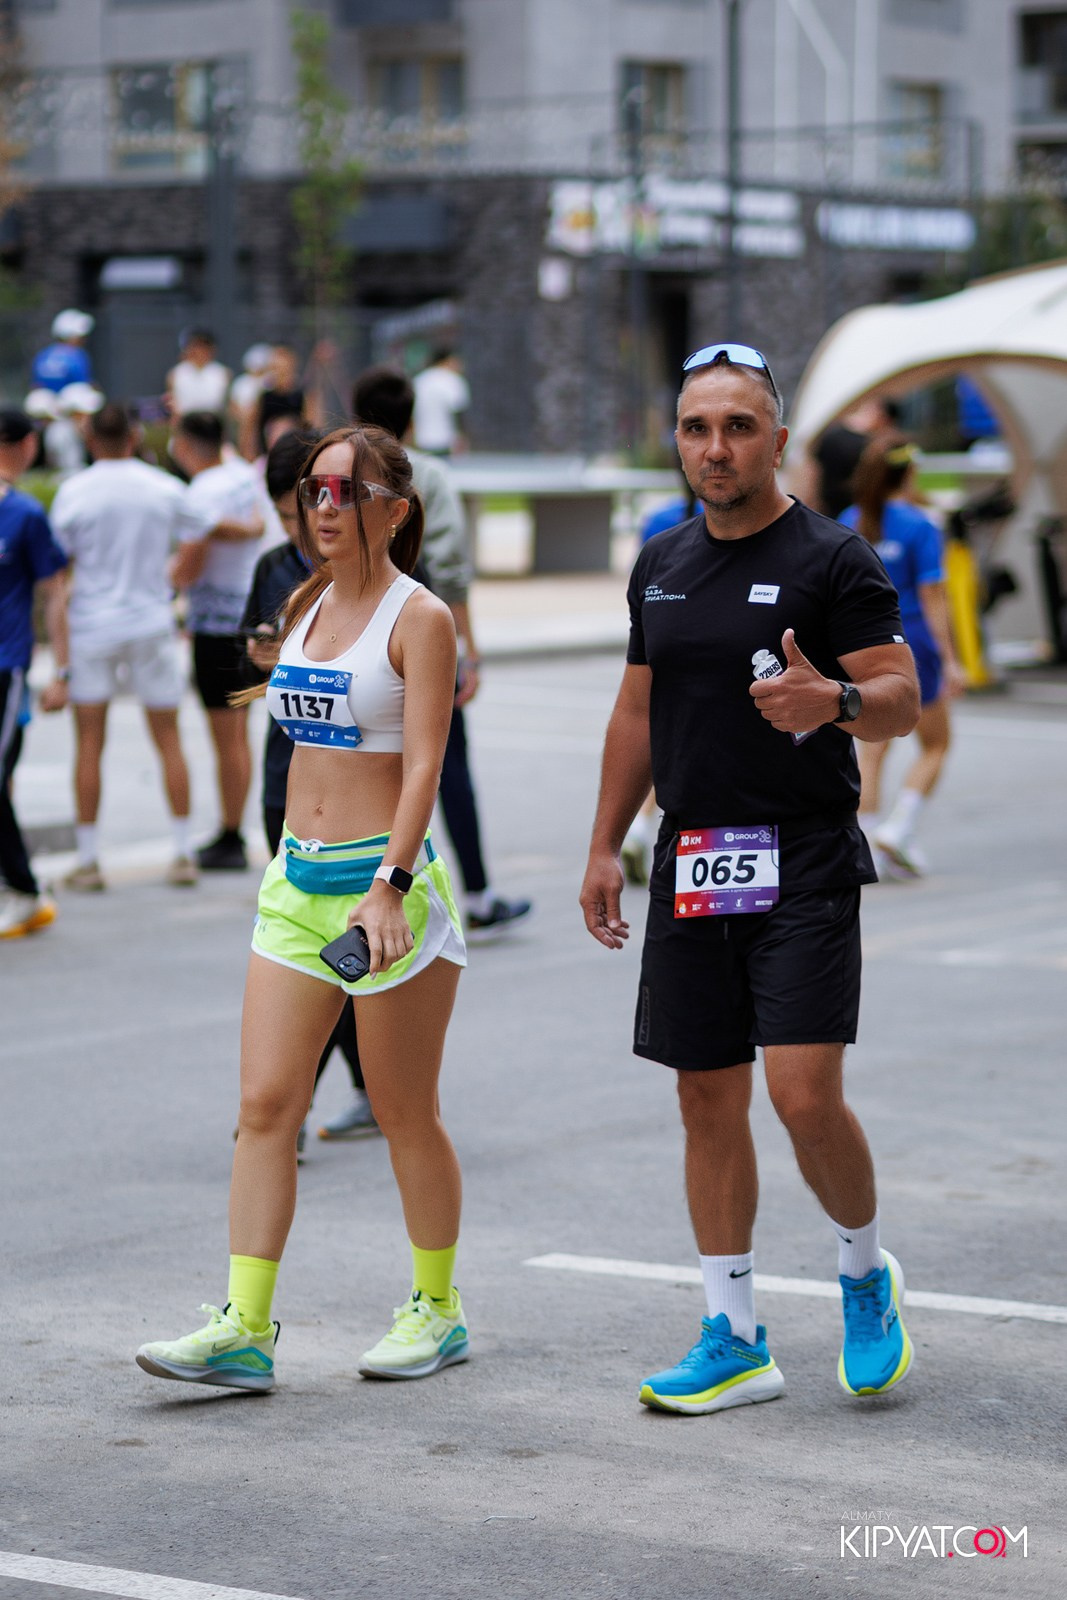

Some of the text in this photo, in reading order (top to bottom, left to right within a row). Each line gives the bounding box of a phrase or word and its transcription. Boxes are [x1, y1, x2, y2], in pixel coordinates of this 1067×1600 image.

[758, 661, 780, 679] 226ERS
[280, 693, 334, 720] 1137
[681, 835, 702, 847] 10 KM
[692, 854, 758, 887] 065
